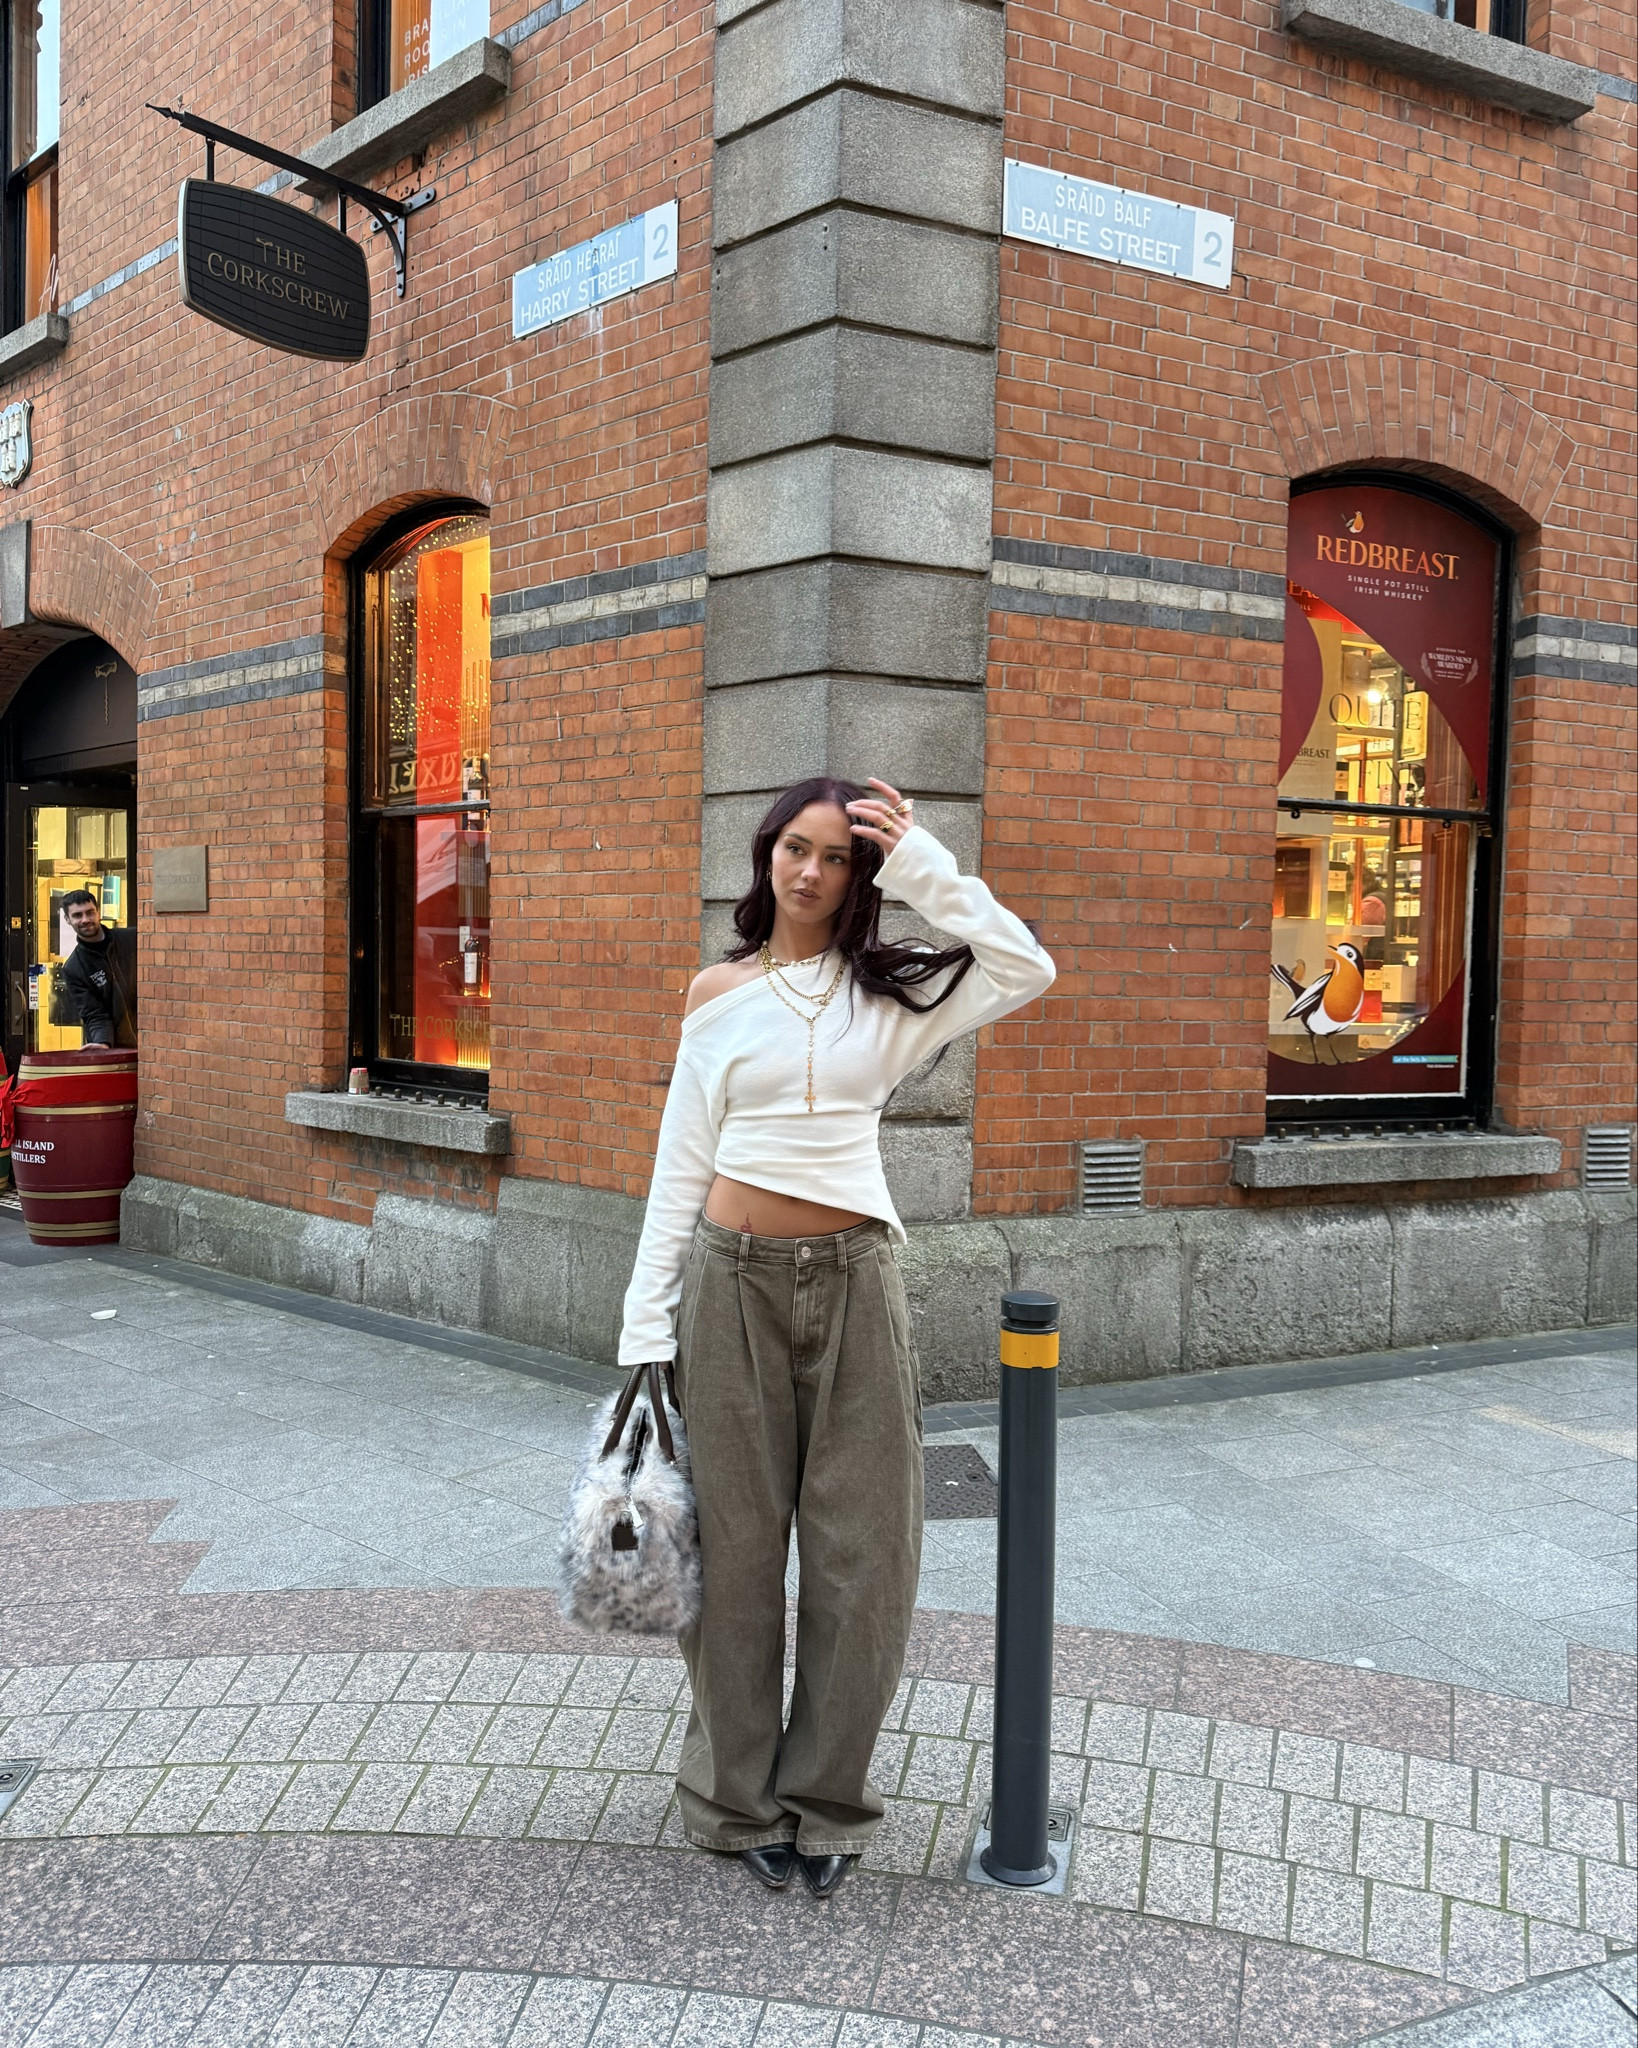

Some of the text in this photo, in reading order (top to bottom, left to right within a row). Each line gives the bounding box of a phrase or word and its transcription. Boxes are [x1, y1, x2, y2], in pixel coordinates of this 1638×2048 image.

[1056, 184, 1152, 229] SRÁID BALF
[653, 223, 669, 260] 2
[1021, 207, 1181, 267] BALFE STREET
[1203, 231, 1222, 267] 2
[255, 237, 306, 275] THE
[207, 252, 350, 320] CORKSCREW
[521, 257, 639, 327] HARRY STREET
[538, 258, 572, 292] SRÁID
[1316, 534, 1461, 580] REDBREAST
[1347, 574, 1430, 593] SINGLE POT STILL
[1354, 585, 1423, 601] IRISH WHISKEY
[1329, 693, 1421, 731] QUITE
[389, 1013, 420, 1037] THE
[22, 1140, 55, 1151] ISLAND
